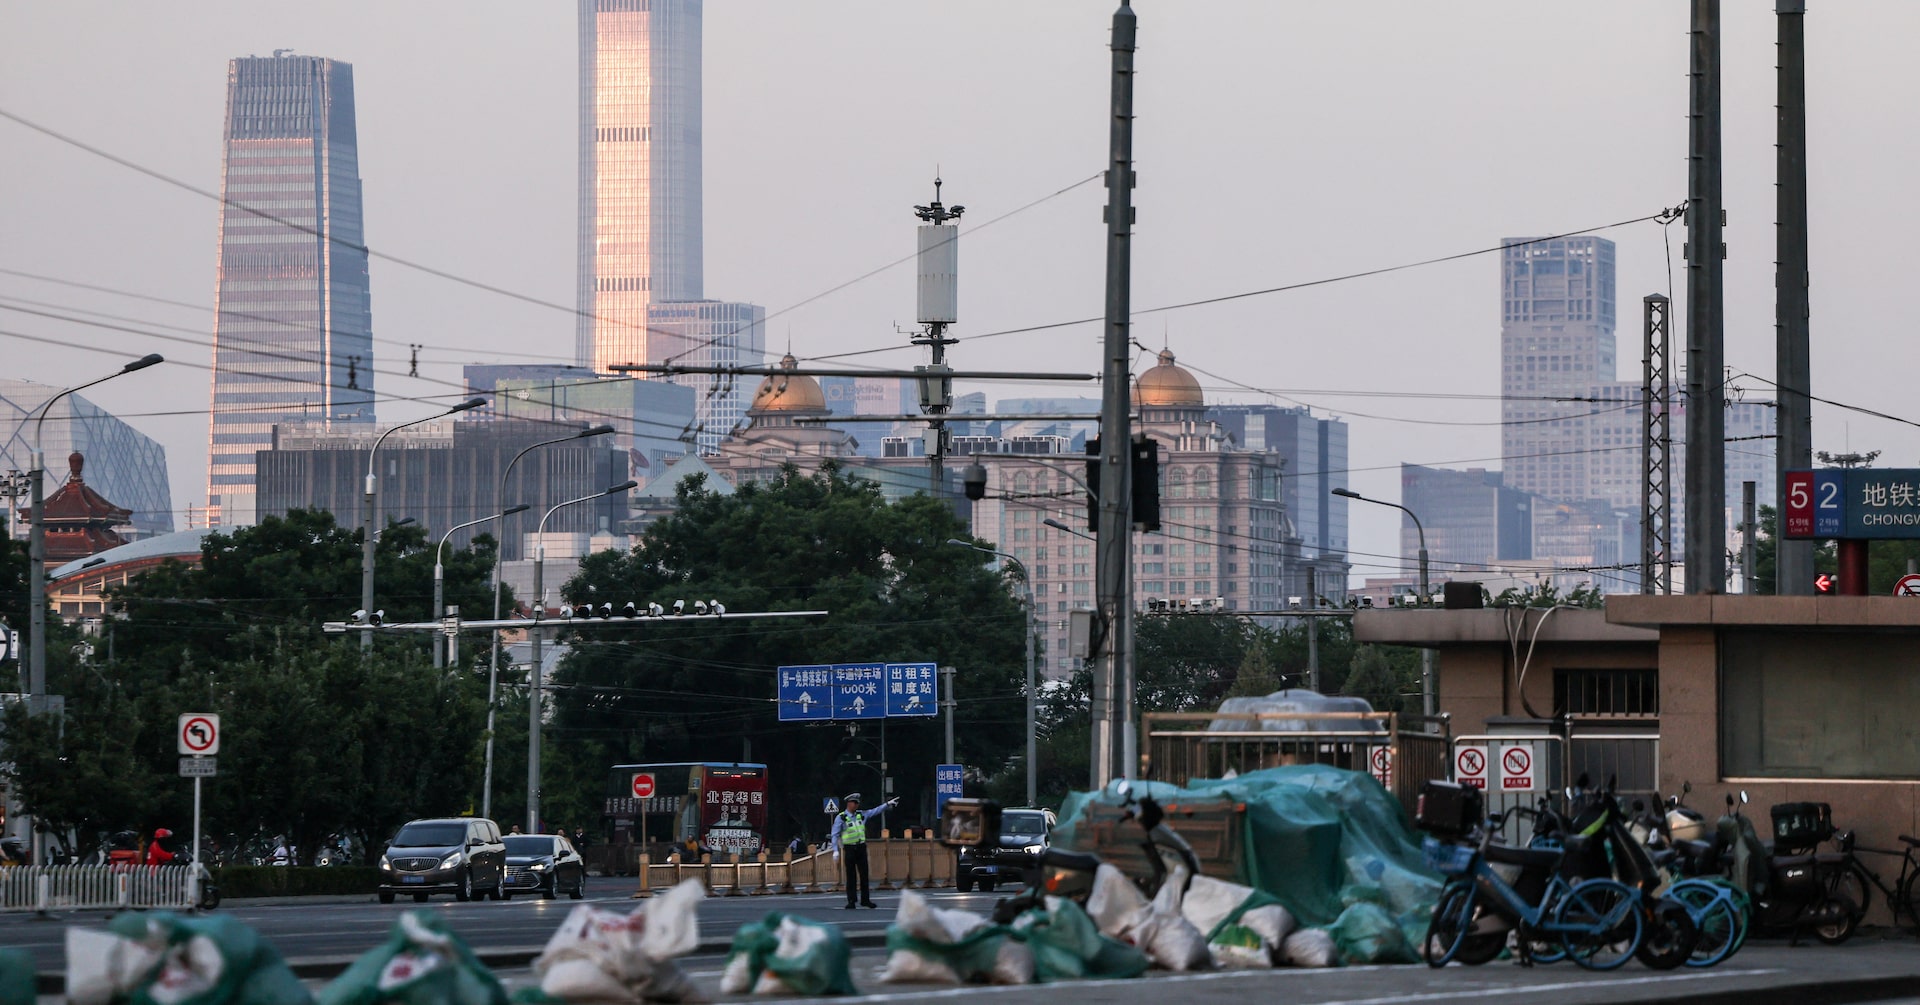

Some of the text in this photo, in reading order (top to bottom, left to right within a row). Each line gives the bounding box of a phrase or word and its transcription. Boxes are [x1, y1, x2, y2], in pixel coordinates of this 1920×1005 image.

[648, 309, 696, 318] SAMSUNG
[1790, 482, 1808, 509] 5
[1819, 482, 1838, 509] 2
[1862, 482, 1920, 507] 地铁
[836, 667, 882, 681] 华通停车场
[891, 667, 931, 680] 出租车
[841, 682, 877, 696] 1000米
[891, 681, 932, 695] 调度站
[938, 770, 961, 781] 出租车
[938, 783, 962, 794] 调度站
[706, 790, 763, 805] 北京华医
